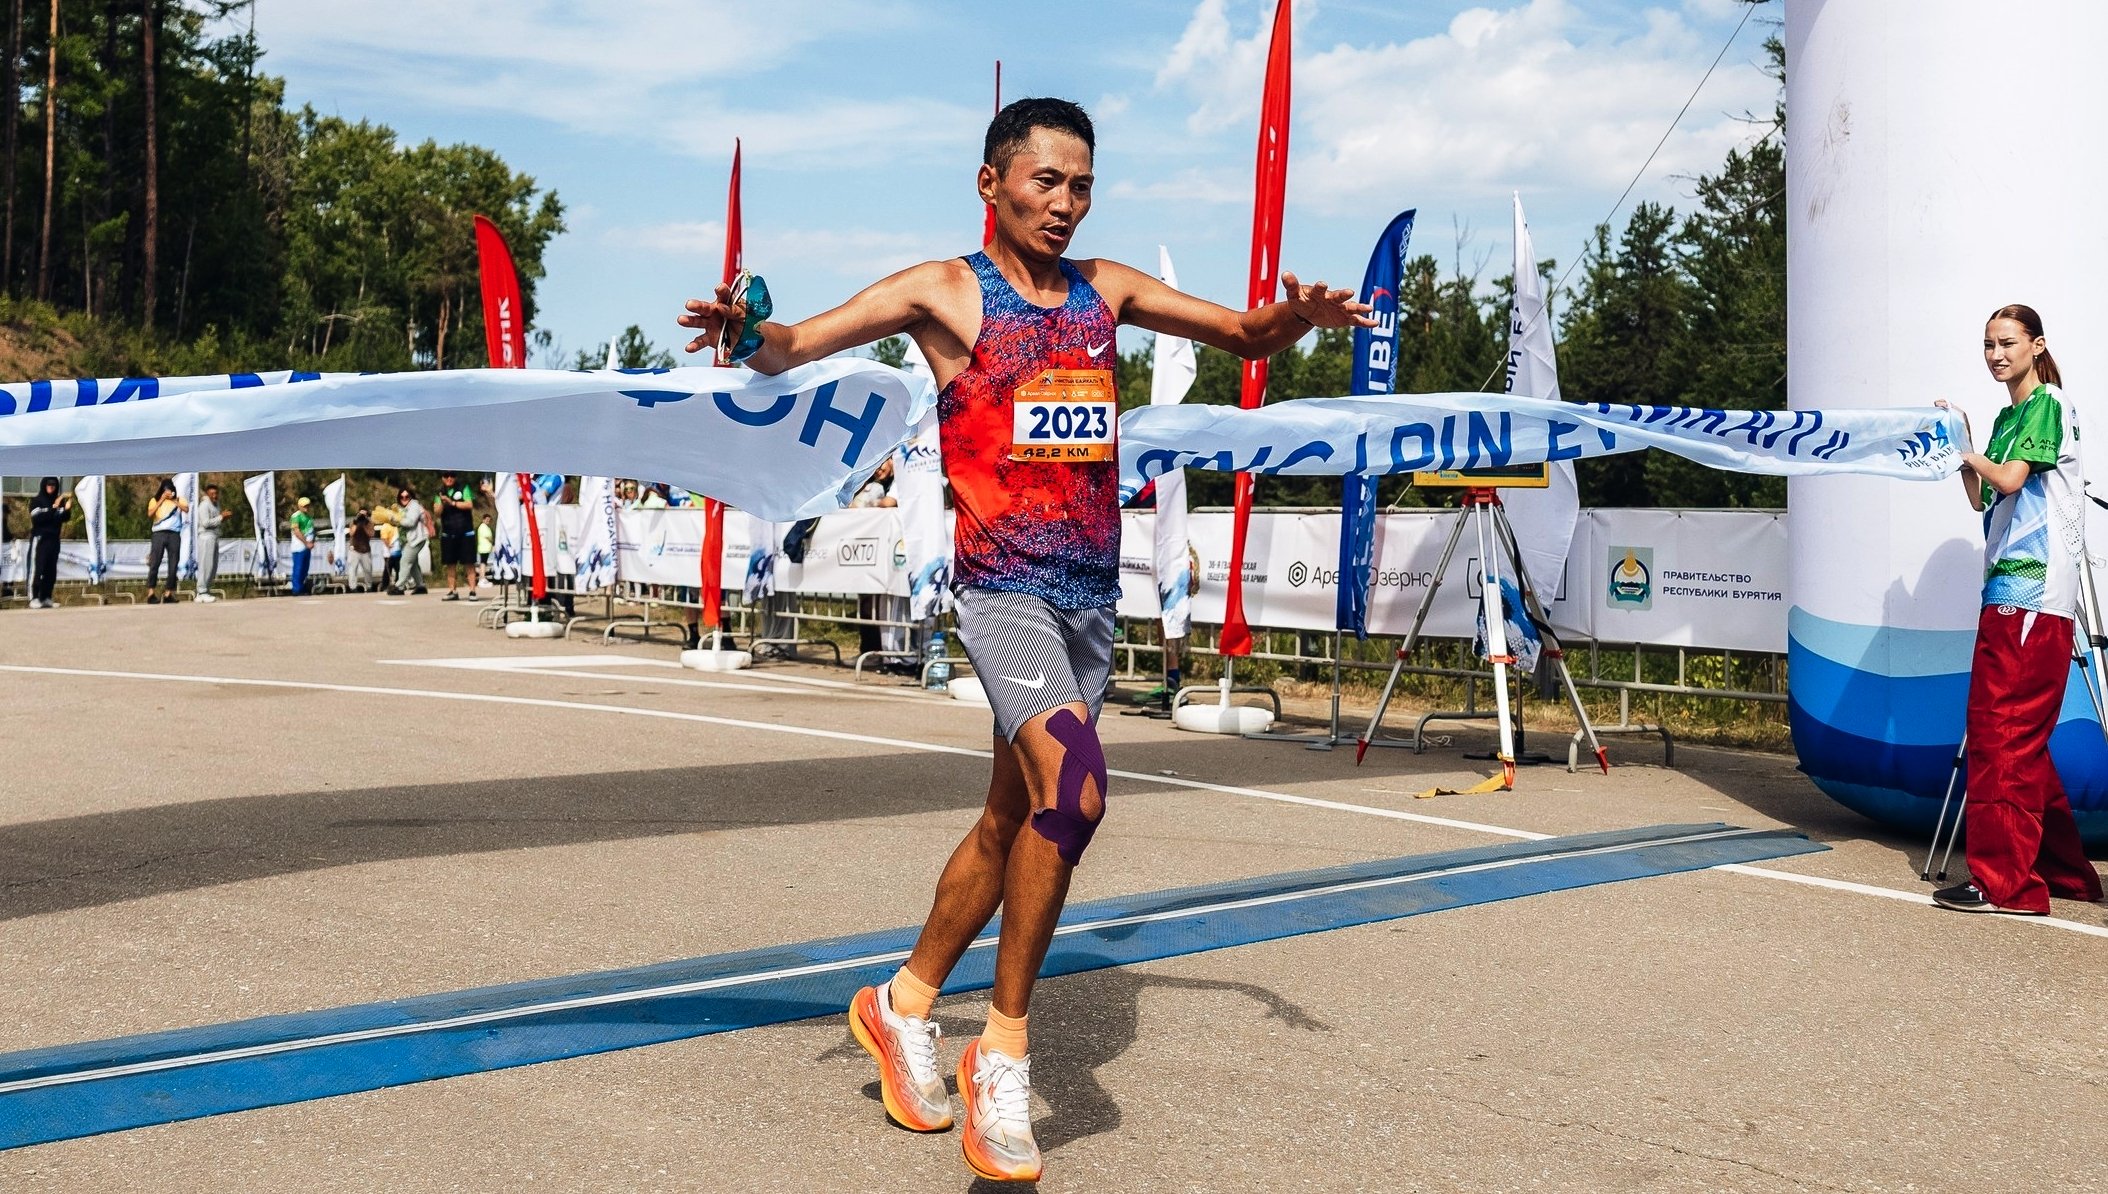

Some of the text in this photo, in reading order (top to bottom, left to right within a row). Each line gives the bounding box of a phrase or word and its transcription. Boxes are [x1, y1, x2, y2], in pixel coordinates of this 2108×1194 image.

[1029, 406, 1108, 439] 2023
[1024, 448, 1061, 458] 42,2
[1663, 571, 1752, 583] ПРАВИТЕЛЬСТВО
[1663, 587, 1782, 601] РЕСПУБЛИКИ БУРЯТИЯ
